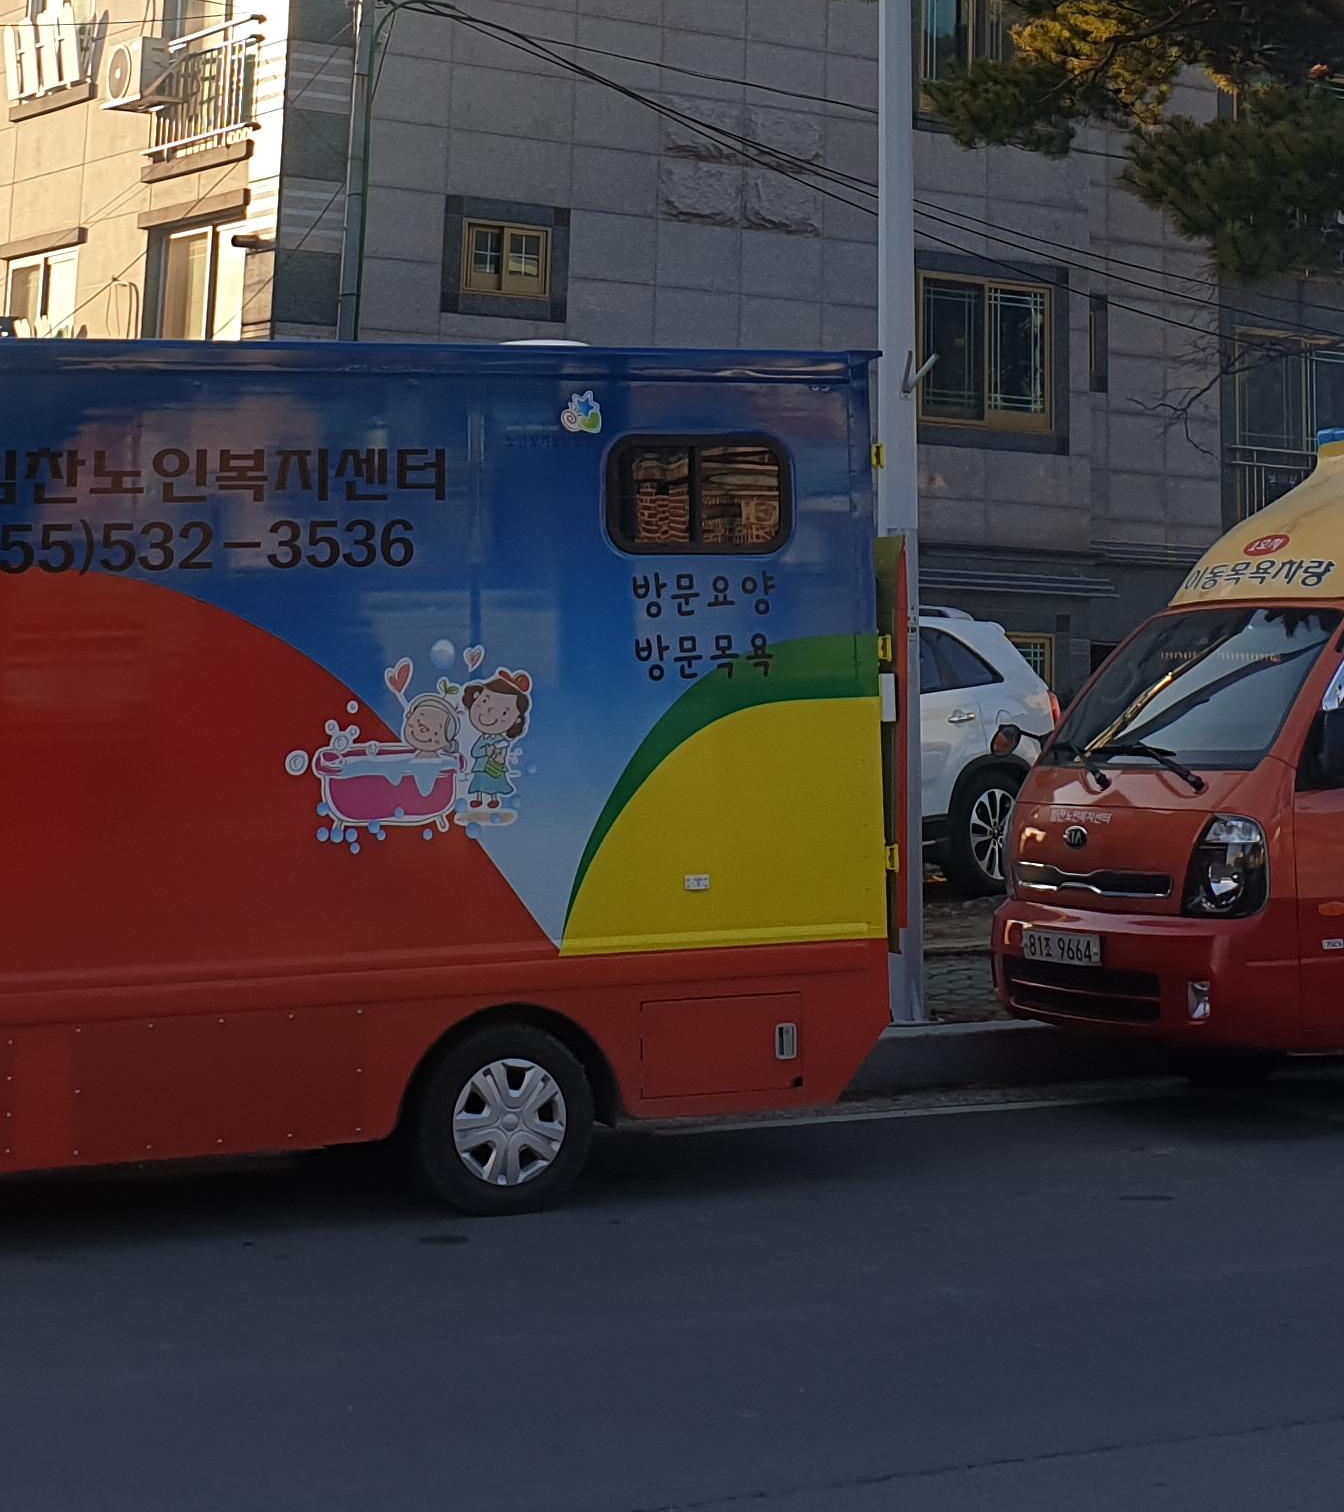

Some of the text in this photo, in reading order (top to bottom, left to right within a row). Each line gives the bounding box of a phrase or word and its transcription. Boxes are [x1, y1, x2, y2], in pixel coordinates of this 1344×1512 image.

[1184, 559, 1335, 587] 이동목욕차량
[632, 570, 776, 618] 방문요양
[635, 632, 773, 681] 방문목욕
[1057, 937, 1093, 962] 9664
